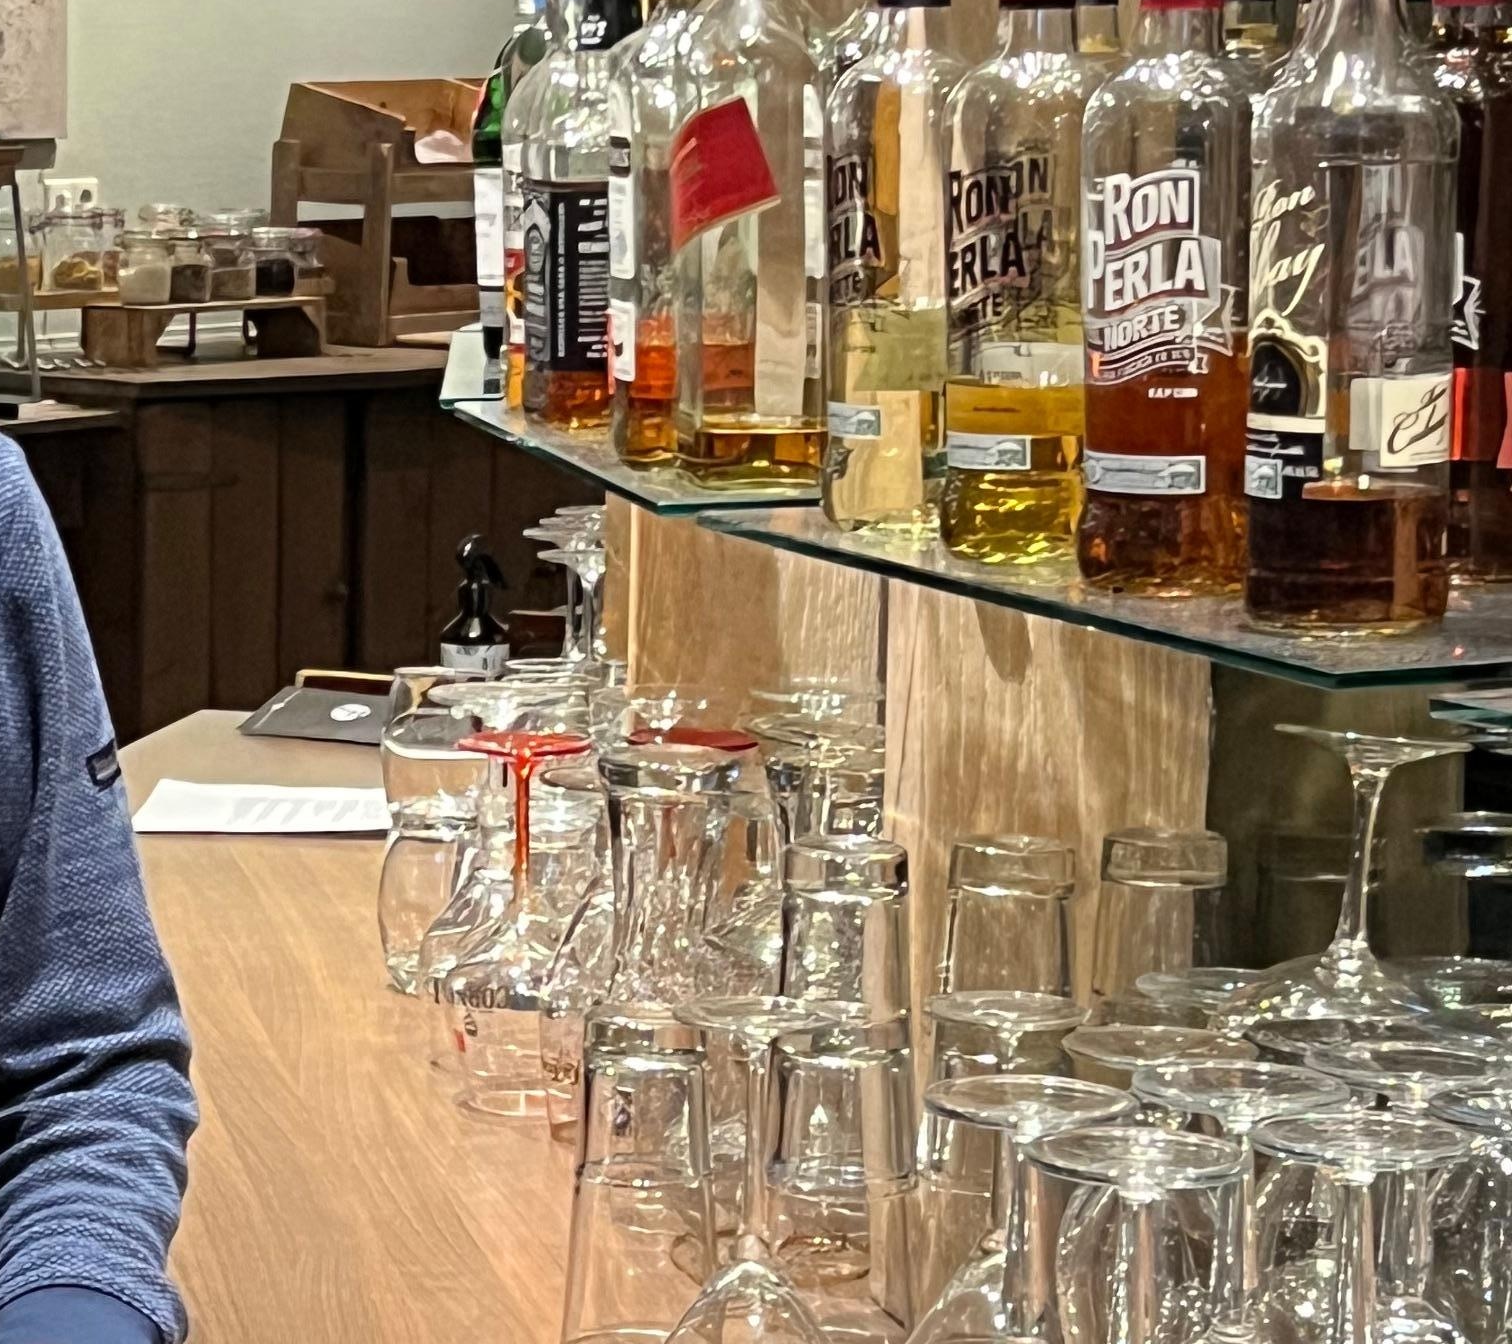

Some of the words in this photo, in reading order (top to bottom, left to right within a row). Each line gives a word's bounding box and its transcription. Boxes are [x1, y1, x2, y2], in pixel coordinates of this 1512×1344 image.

[1104, 172, 1189, 246] RON
[949, 230, 1026, 297] ERLA
[1088, 228, 1206, 312] PERLA
[1104, 304, 1181, 353] NORTE
